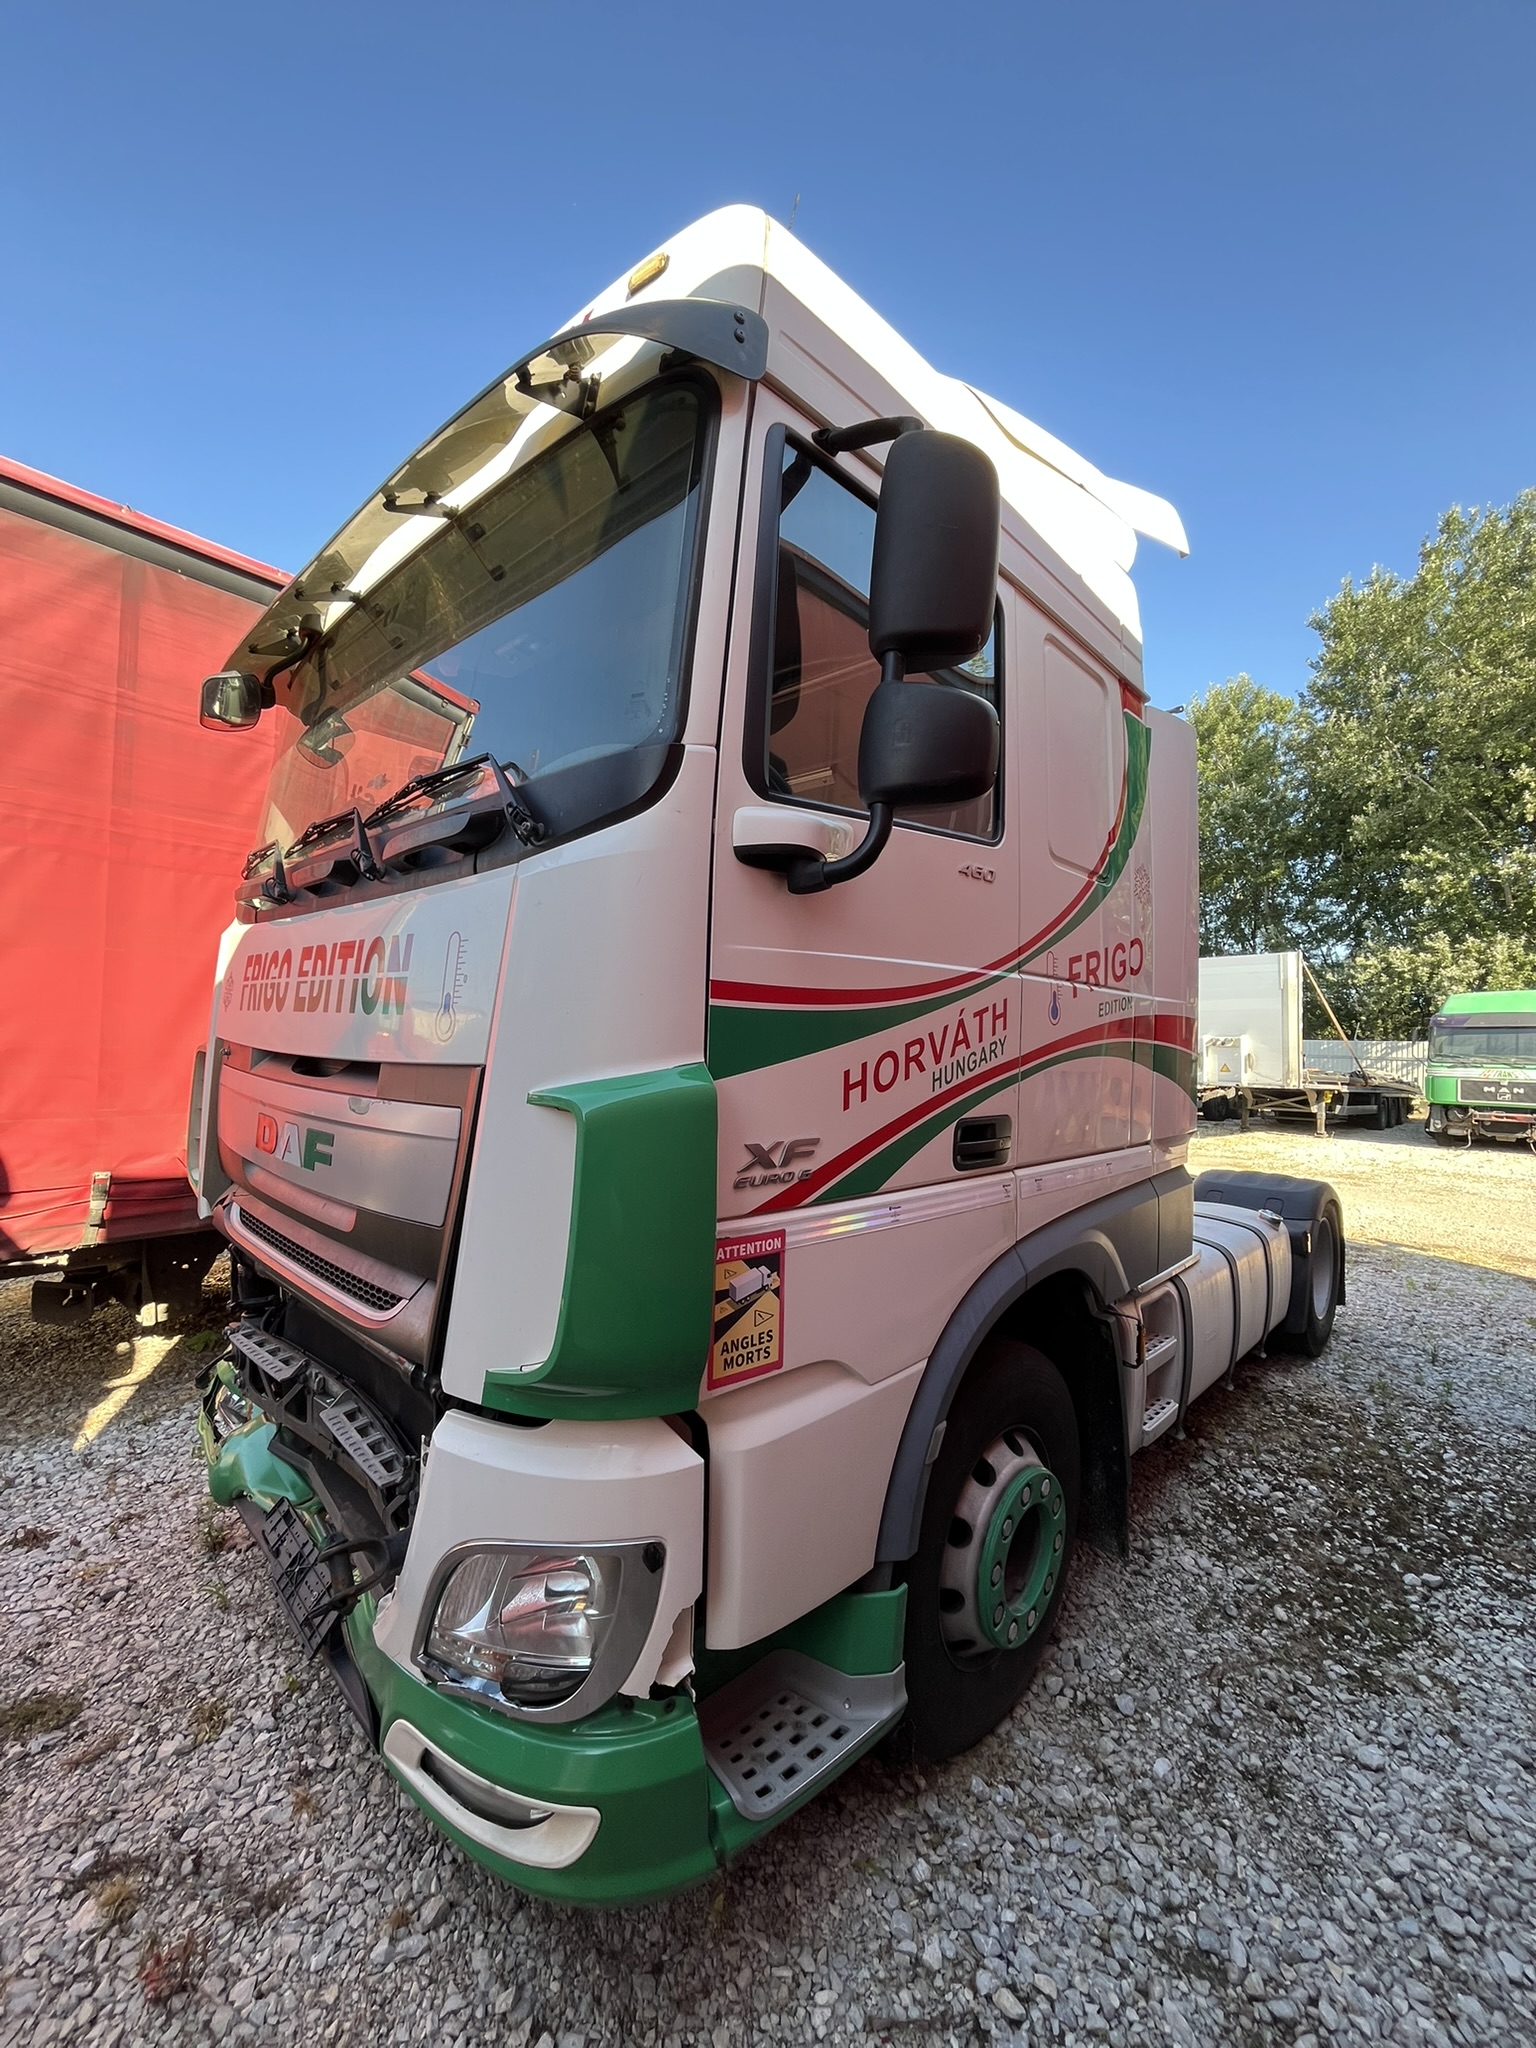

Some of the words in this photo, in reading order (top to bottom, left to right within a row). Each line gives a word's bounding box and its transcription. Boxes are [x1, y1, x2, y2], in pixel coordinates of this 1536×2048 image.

[958, 864, 997, 884] 460
[240, 947, 293, 1013] FRIGO
[293, 933, 415, 1016] EDITION
[1067, 937, 1144, 999] FRIGO
[1098, 996, 1134, 1018] EDITION
[843, 997, 1008, 1112] HORVÁTH
[932, 1035, 1007, 1092] HUNGARY
[1482, 1086, 1525, 1094] MAN
[256, 1112, 336, 1172] DAF
[737, 1138, 821, 1174] XF
[733, 1171, 796, 1190] EURO
[797, 1168, 813, 1181] 6
[716, 1237, 782, 1261] ATTENTION
[720, 1329, 774, 1357] ANGLES
[722, 1346, 771, 1372] MORTS
